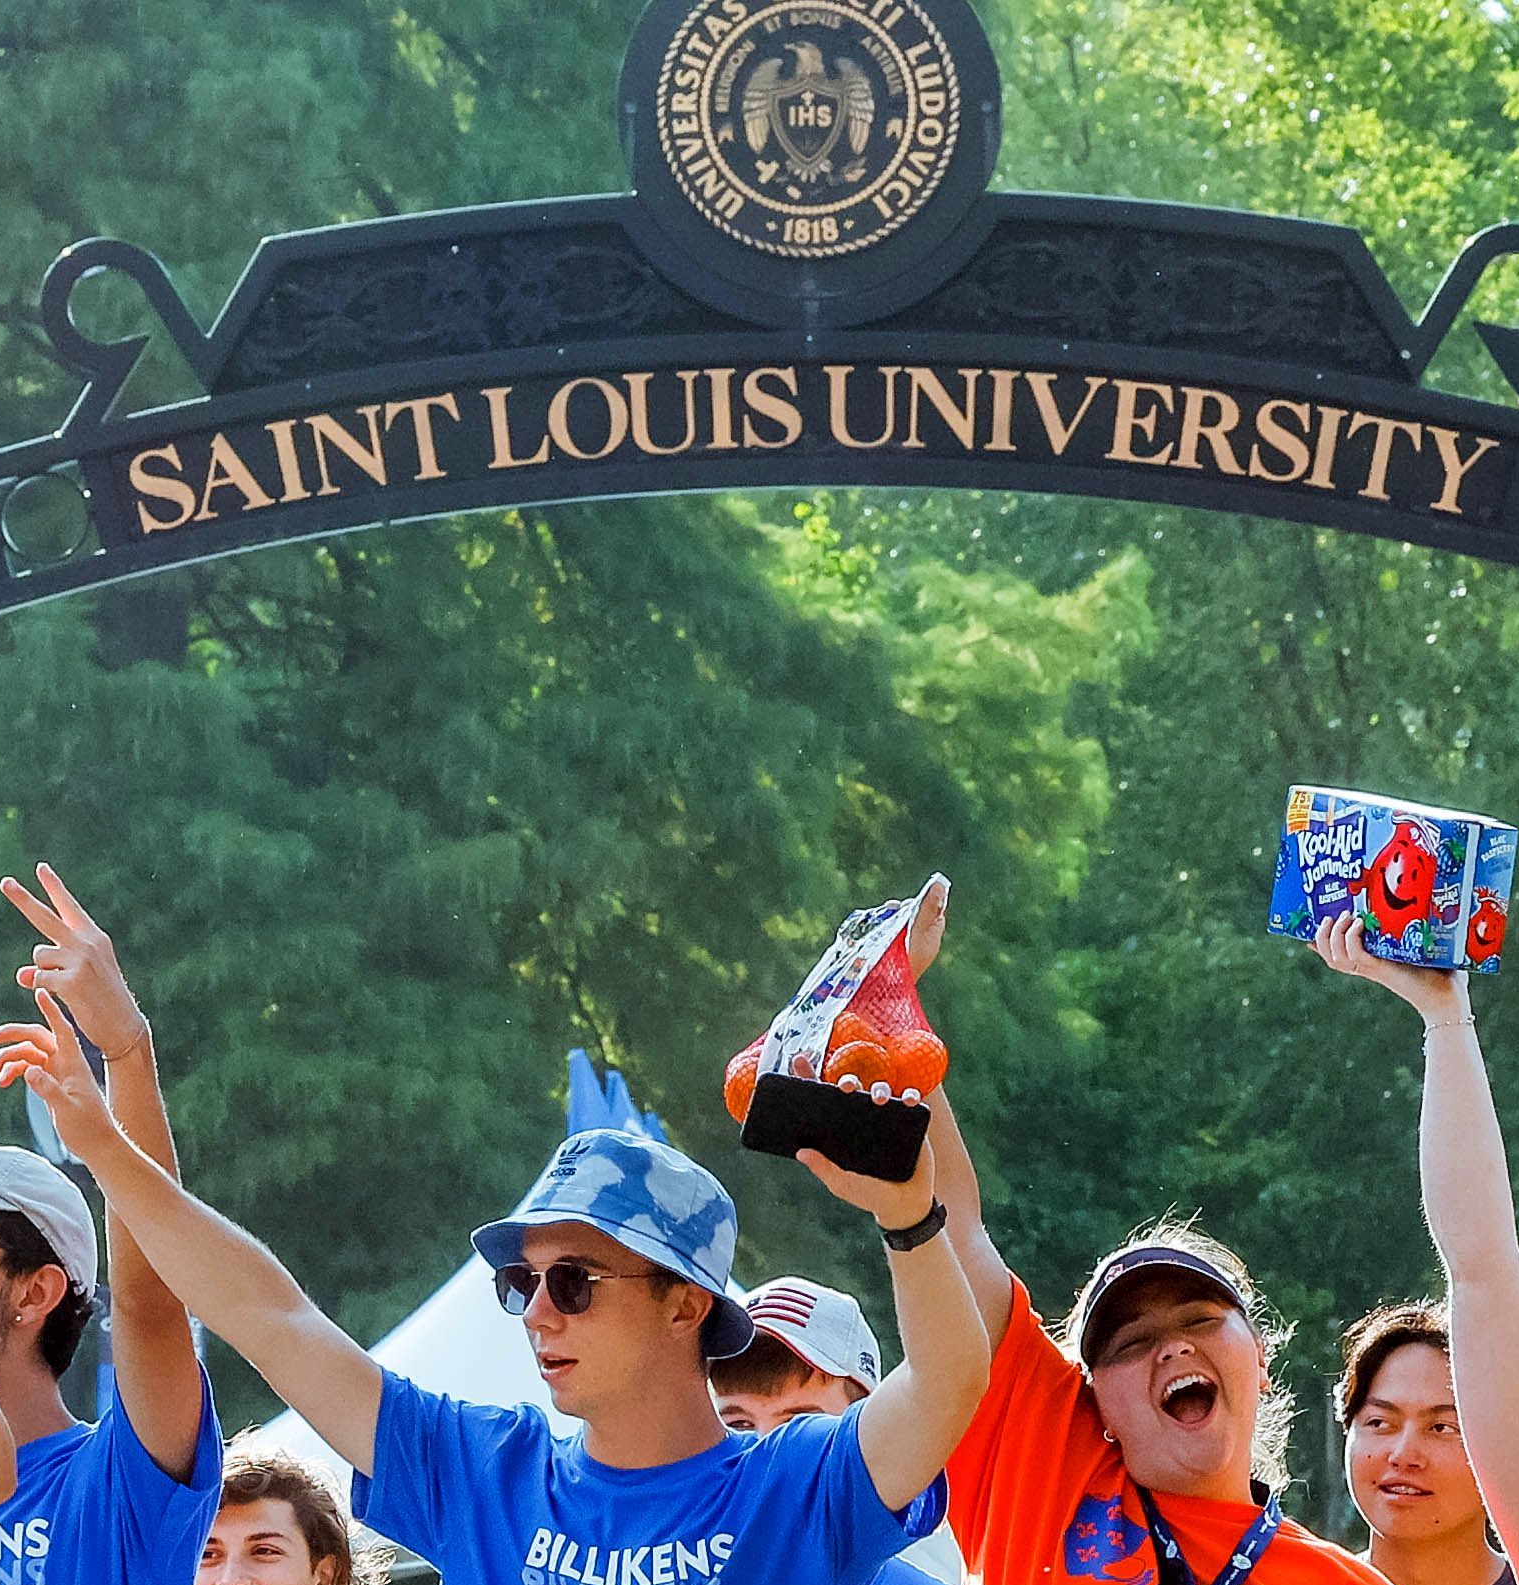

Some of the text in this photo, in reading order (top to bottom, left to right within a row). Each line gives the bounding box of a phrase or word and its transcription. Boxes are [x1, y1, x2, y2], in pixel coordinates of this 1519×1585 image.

[789, 107, 832, 128] IHS
[873, 41, 947, 218] LUDOVICI
[784, 217, 840, 245] 1818
[129, 366, 1500, 533] SAINT LOUIS UNIVERSITY
[1298, 817, 1365, 867] Kool-Aid
